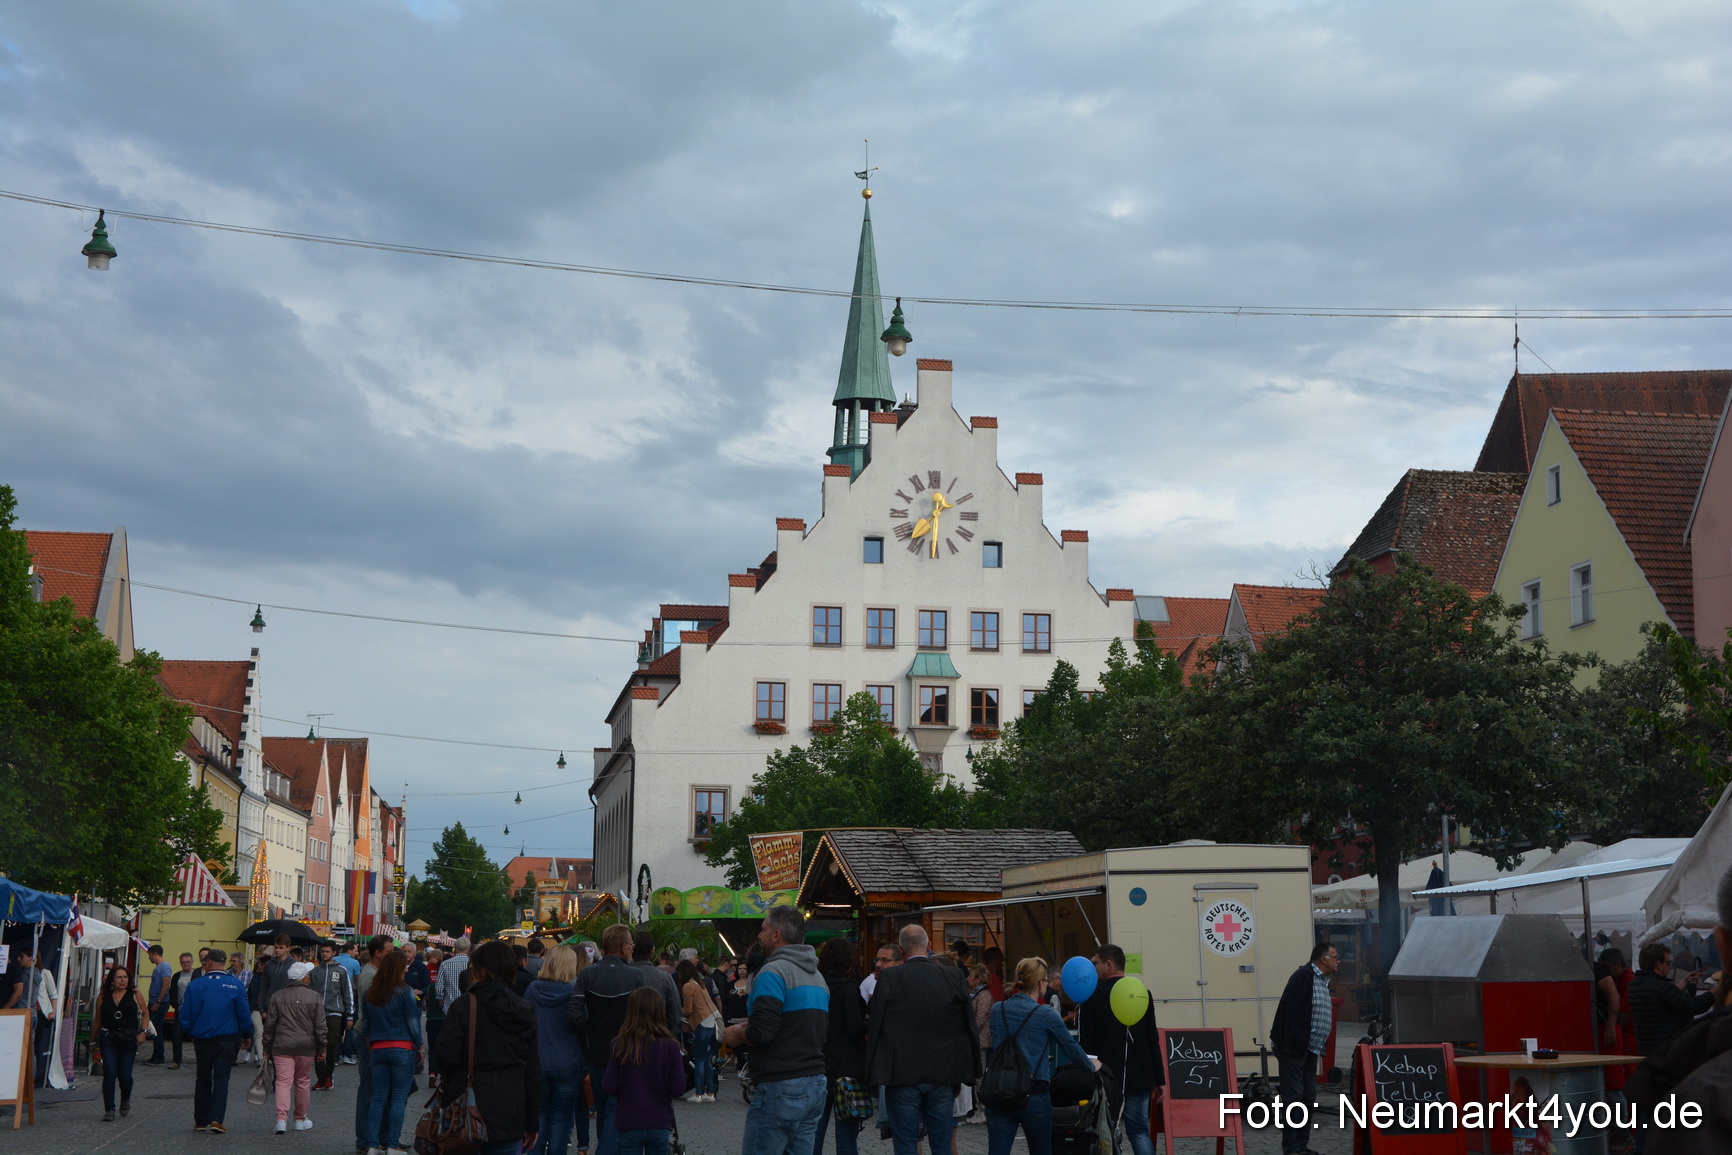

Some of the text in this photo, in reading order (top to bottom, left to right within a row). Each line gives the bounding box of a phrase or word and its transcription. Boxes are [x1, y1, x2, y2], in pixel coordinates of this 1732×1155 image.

[768, 850, 800, 871] lachs
[1206, 903, 1249, 922] DEUTSCHES
[1205, 928, 1252, 952] ROTES KREUZ
[1169, 1036, 1222, 1064] Kebap
[1375, 1052, 1437, 1080] Kebap
[1375, 1080, 1444, 1102] Teller
